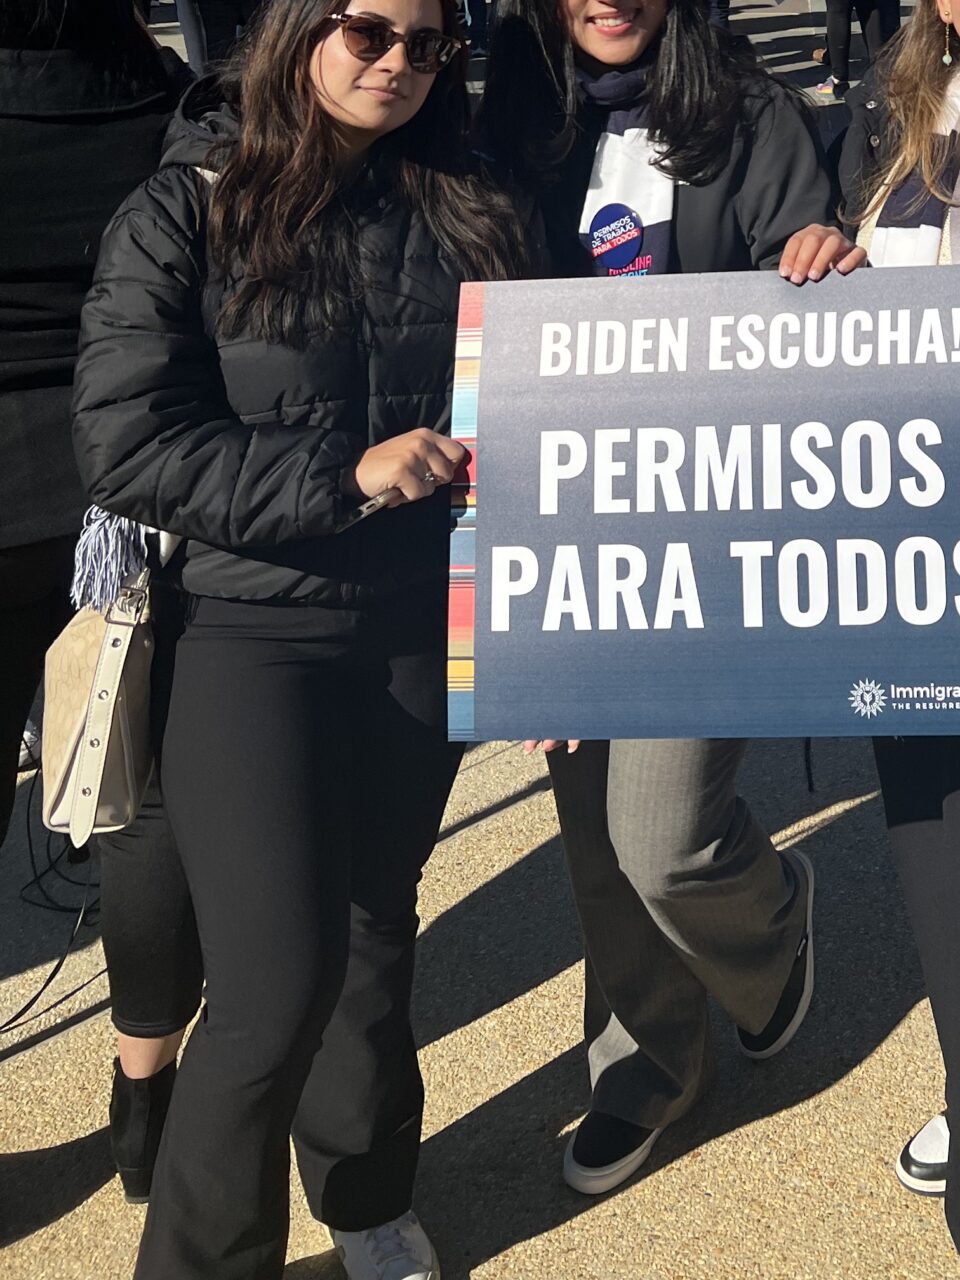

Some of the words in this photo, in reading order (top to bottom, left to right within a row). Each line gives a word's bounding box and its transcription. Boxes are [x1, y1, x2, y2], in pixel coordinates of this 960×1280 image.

[592, 238, 601, 247] DE
[603, 222, 634, 242] TRABAJO
[593, 216, 630, 238] PERMISOS
[594, 242, 611, 256] PARA
[612, 229, 638, 247] TODOS
[539, 317, 689, 377] BIDEN
[539, 418, 946, 515] PERMISOS
[489, 542, 705, 632] PARA
